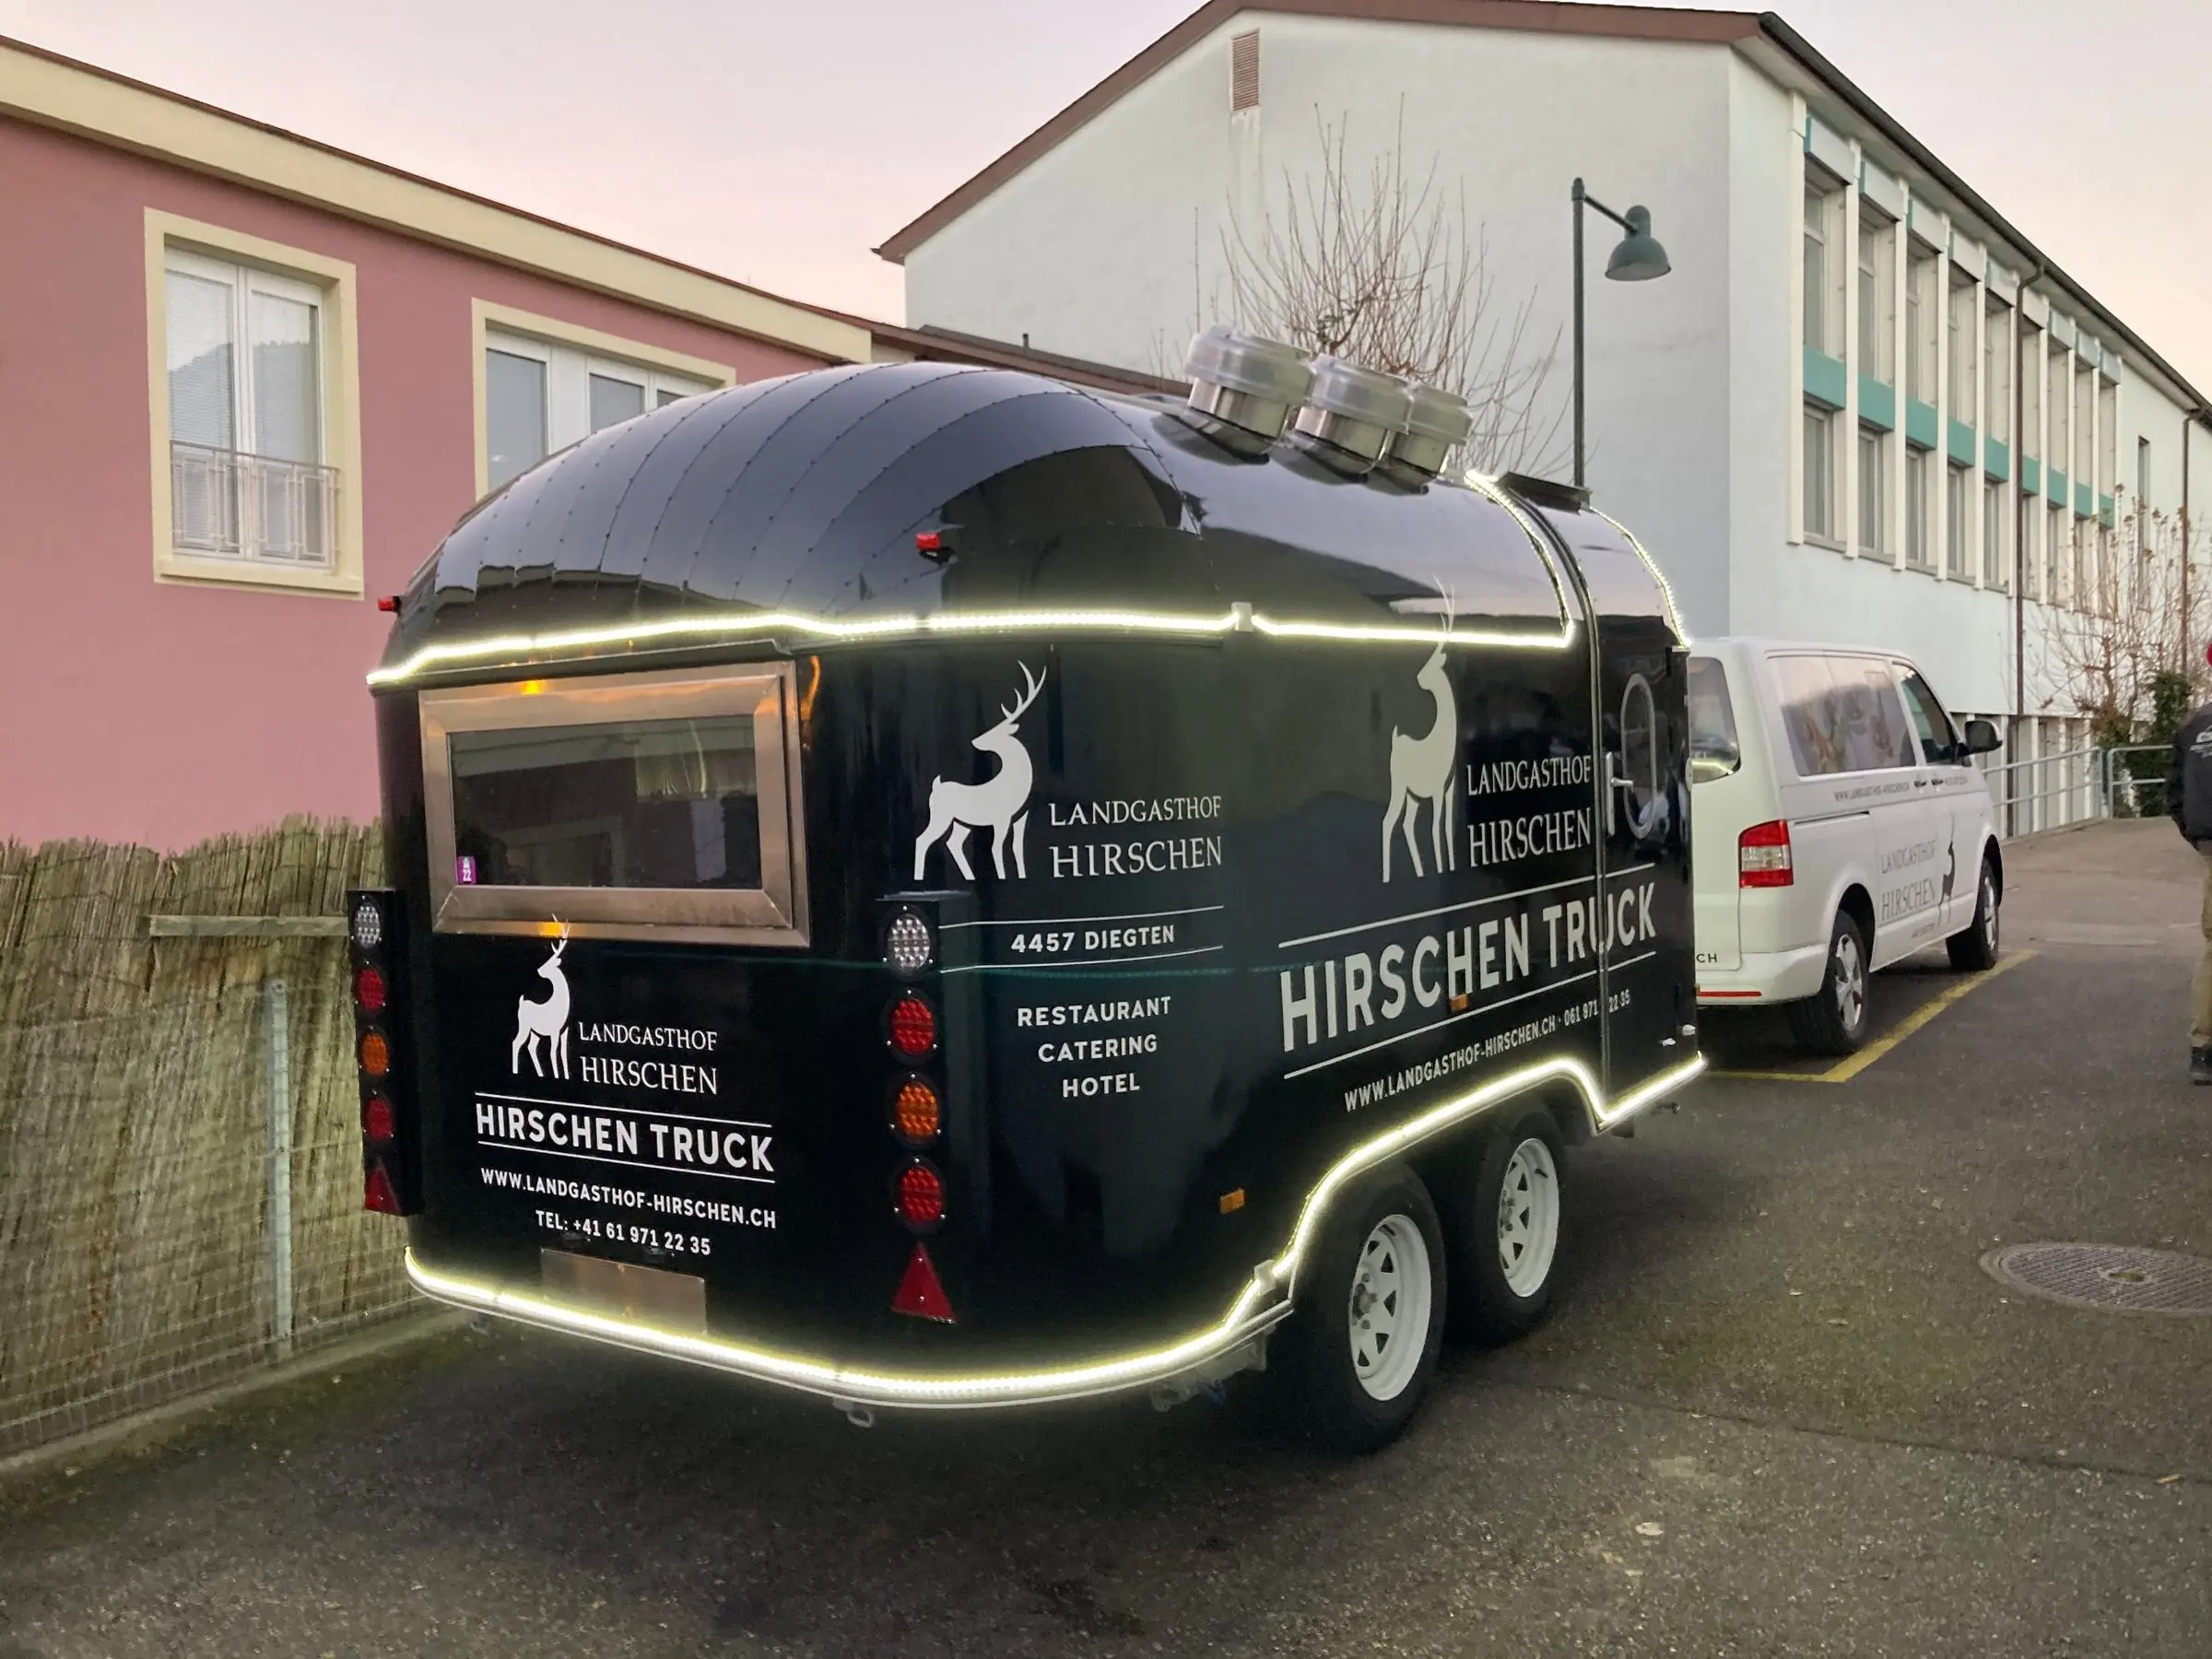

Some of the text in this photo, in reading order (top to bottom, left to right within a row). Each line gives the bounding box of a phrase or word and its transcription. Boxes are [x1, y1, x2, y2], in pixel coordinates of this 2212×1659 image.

[1467, 754, 1592, 796] LANDGASTHOF
[1048, 795, 1221, 826] LANDGASTHOF
[1049, 835, 1222, 878] HIRSCHEN
[1467, 806, 1592, 868] HIRSCHEN
[1010, 924, 1174, 953] 4457 DIEGTEN
[1279, 882, 1658, 1053] HIRSCHEN TRUCK
[1018, 995, 1171, 1027] RESTAURANT
[578, 1021, 718, 1052] LANDGASTHOF
[1038, 1033, 1158, 1063] CATERING
[580, 1055, 717, 1095] HIRSCHEN
[1344, 1014, 1556, 1112] WWW.LANDGASTHOF-HIRSCHEN.CH
[1564, 1005, 1581, 1026] 061
[1063, 1072, 1140, 1098] HOTEL
[476, 1103, 774, 1172] HIRSCHEN TRUCK
[480, 1167, 776, 1230] WWW.LANDGASTHOF-HIRSCHEN.CH
[535, 1209, 711, 1255] TEL: +41 61 971 22 35
